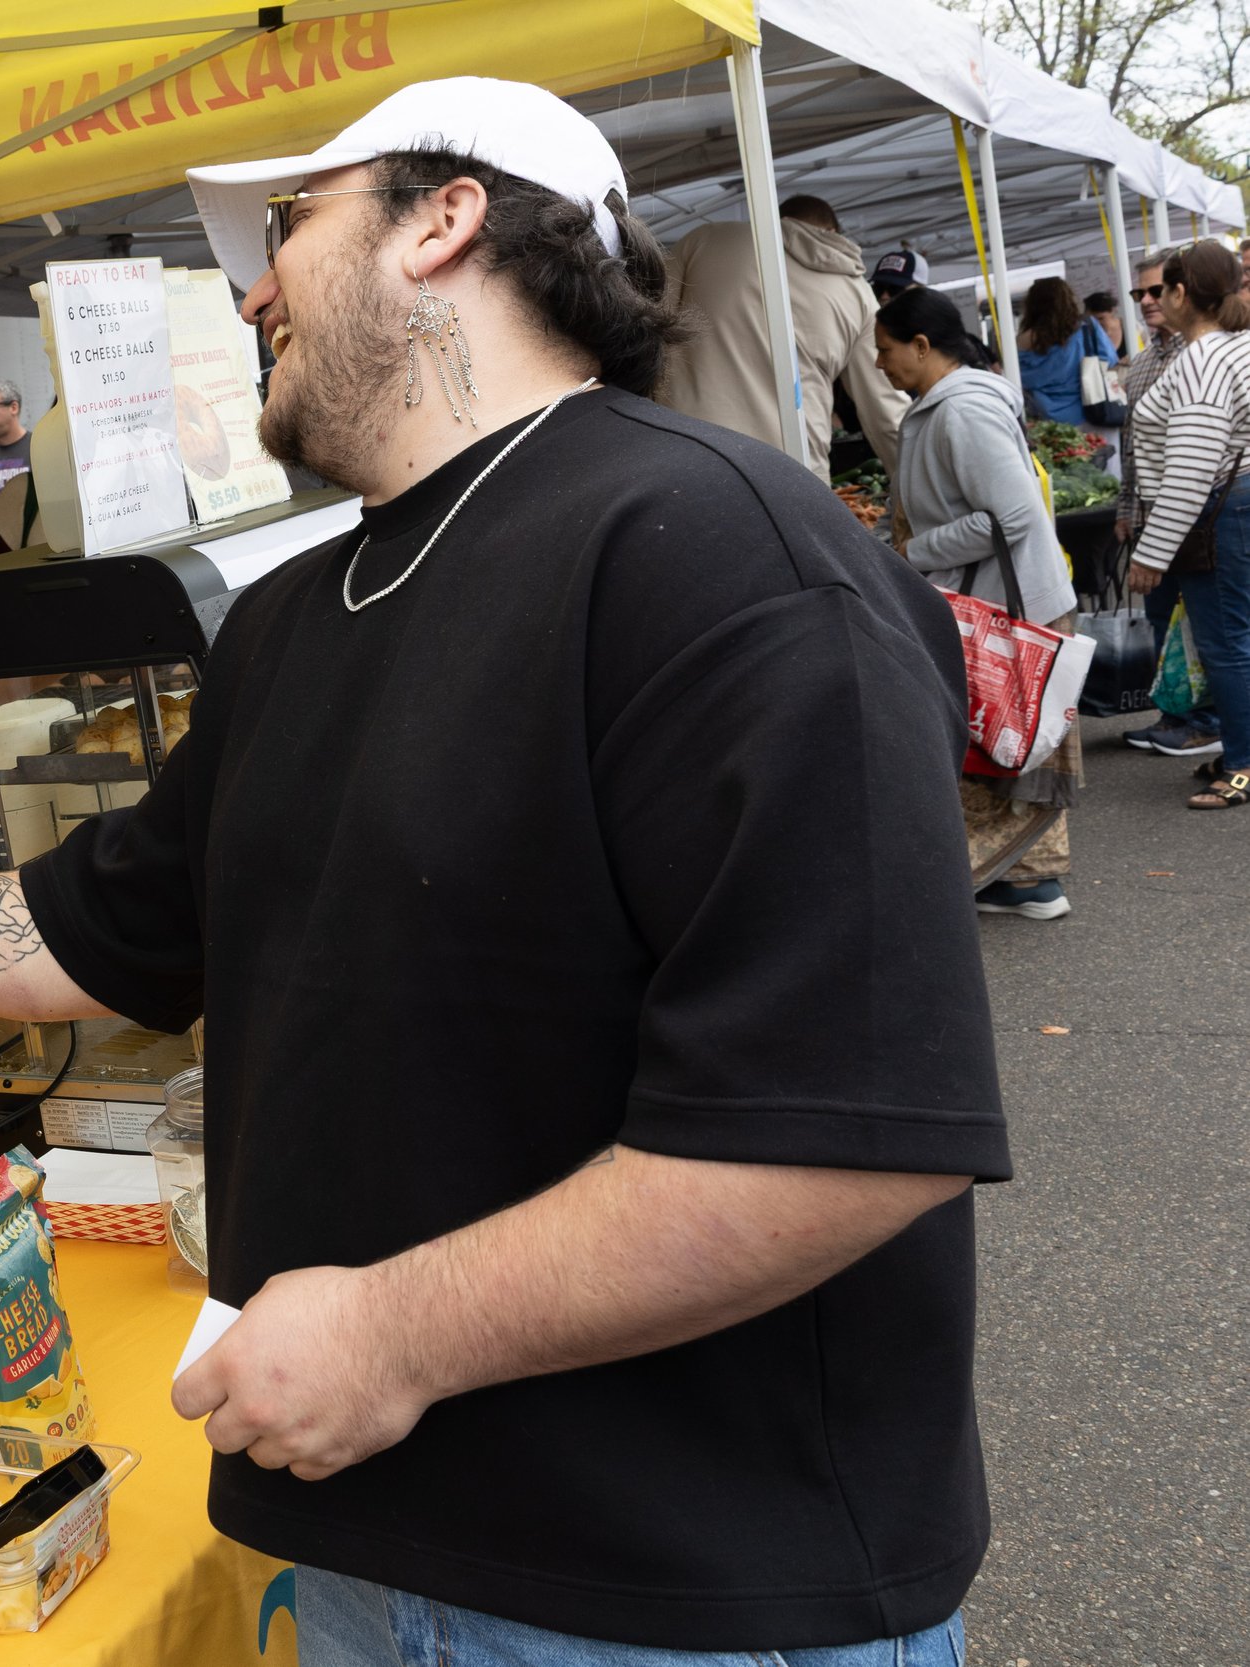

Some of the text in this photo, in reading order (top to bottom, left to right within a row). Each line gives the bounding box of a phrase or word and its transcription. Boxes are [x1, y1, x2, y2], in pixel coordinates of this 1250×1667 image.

[56, 264, 146, 287] READY TO EAT
[68, 299, 150, 320] 6 CHEESE BALLS
[98, 321, 121, 335] $7.50
[70, 340, 155, 364] 12 CHEESE BALLS
[101, 370, 126, 385] $11.50
[70, 403, 88, 416] TWO
[89, 397, 123, 412] FLAVORS
[129, 395, 141, 405] MIX
[97, 489, 128, 506] CHEDDAR
[128, 483, 150, 497] CHEESE
[207, 485, 241, 511] $5.50
[98, 508, 121, 522] GUAVA
[122, 501, 142, 516] SAUCE
[4, 1303, 48, 1360] BREAD
[9, 1321, 60, 1378] GARLIC & ONION
[6, 1440, 30, 1466] 20
